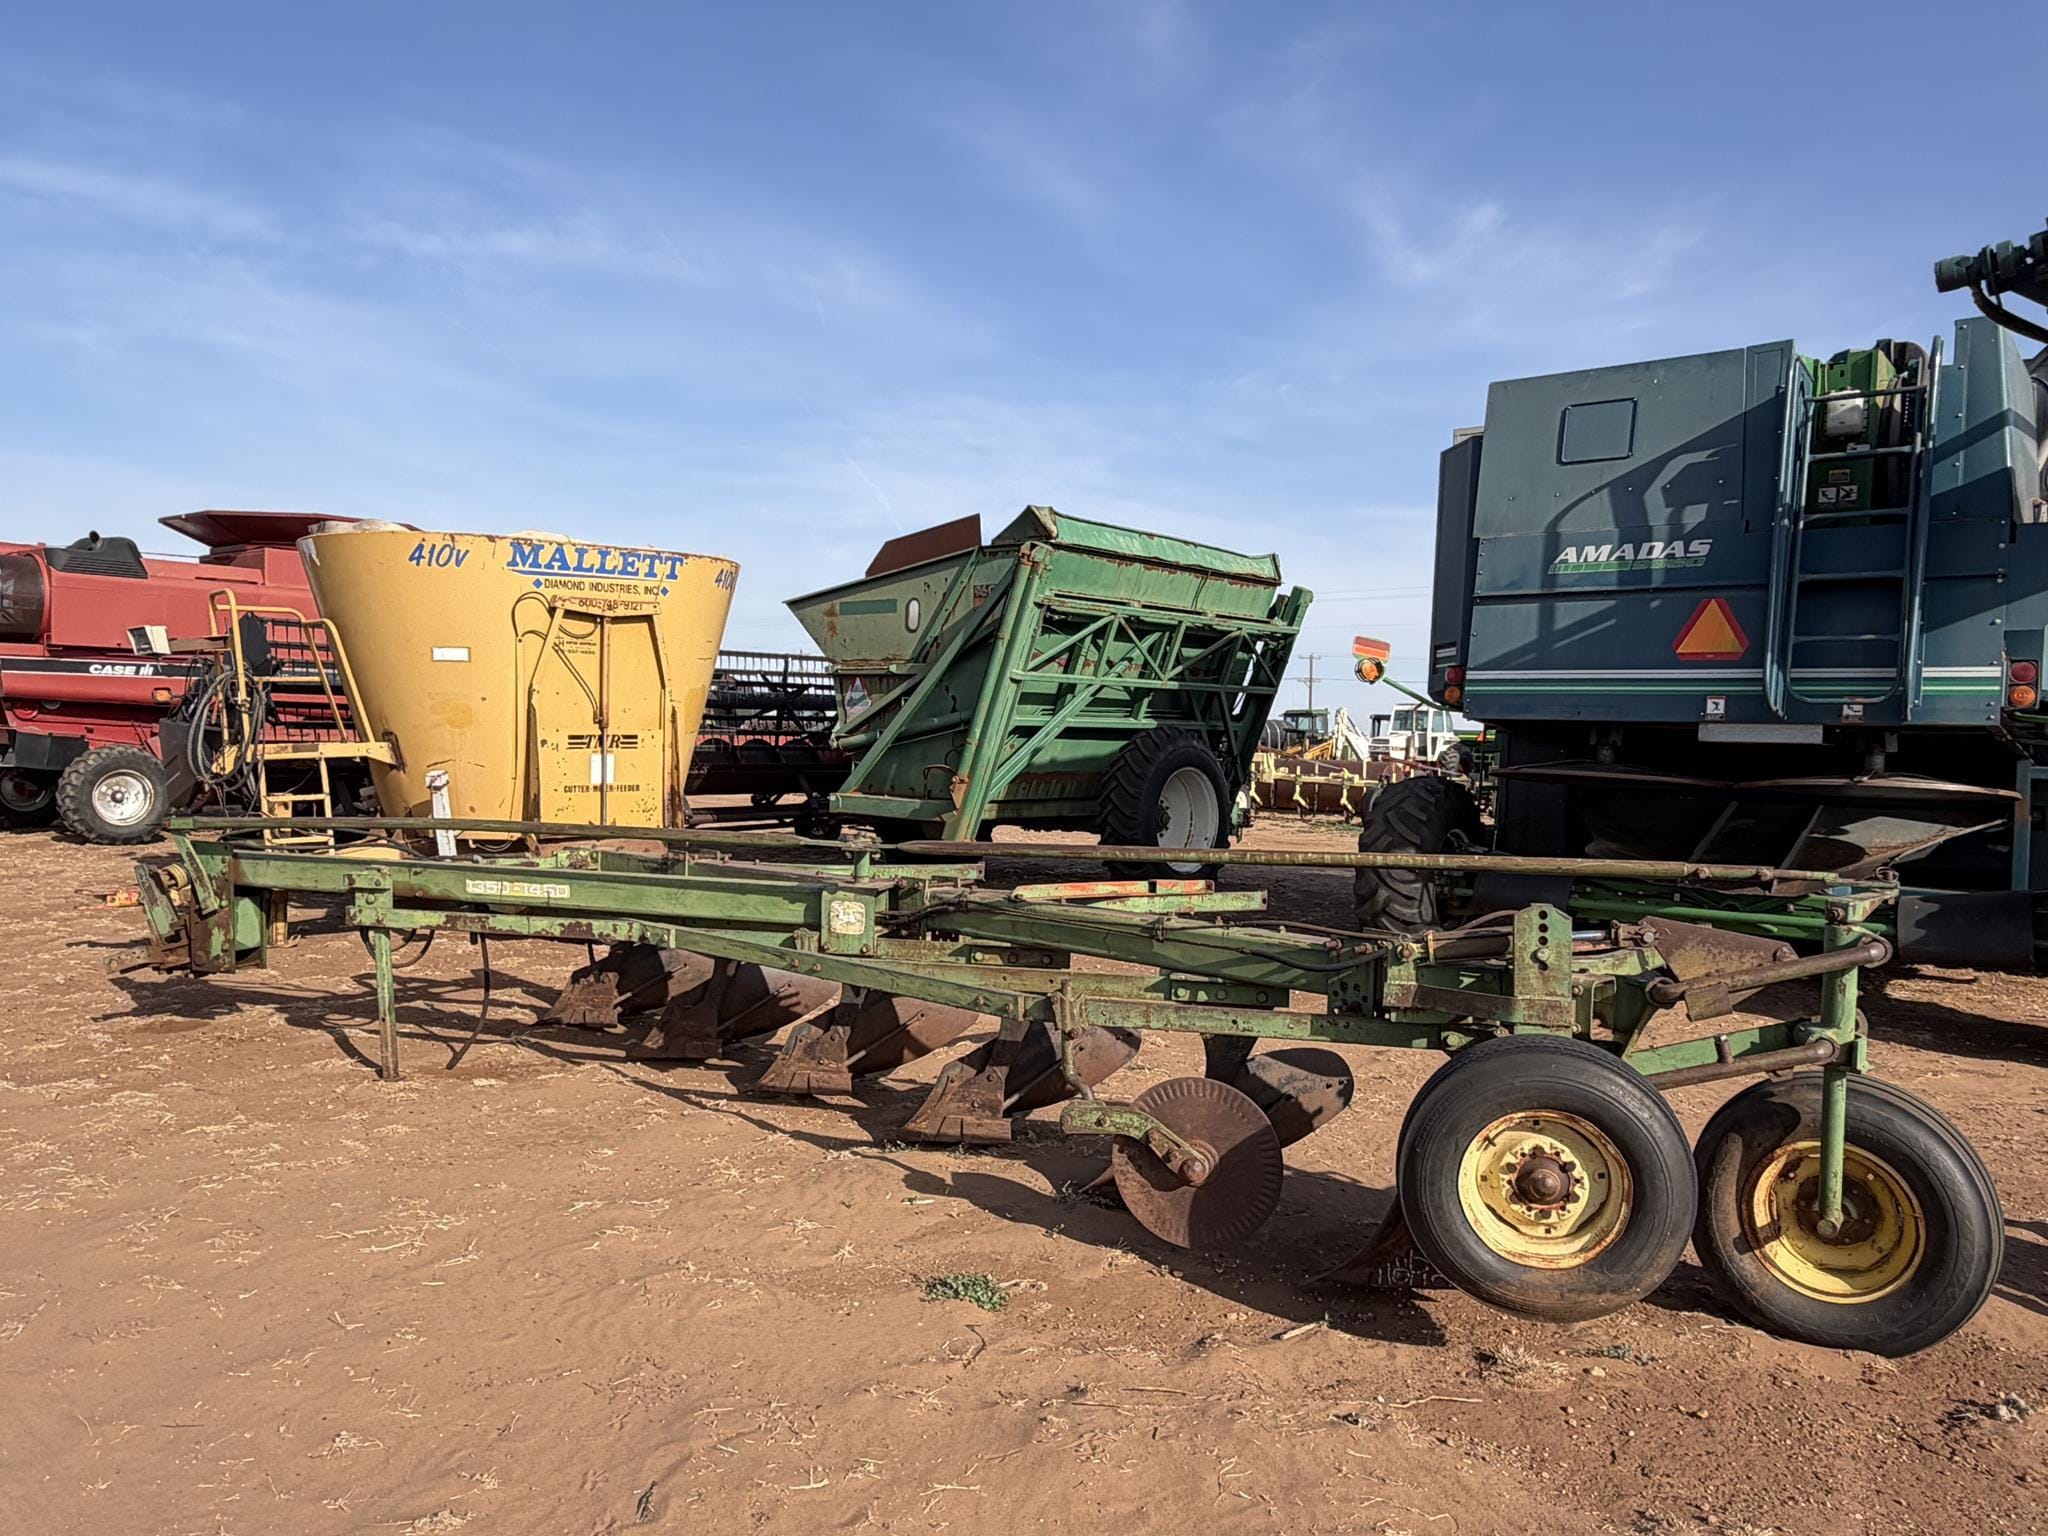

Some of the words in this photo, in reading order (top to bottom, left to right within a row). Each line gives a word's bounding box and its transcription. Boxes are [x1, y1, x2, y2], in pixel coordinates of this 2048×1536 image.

[506, 541, 684, 581] MALLETT
[1553, 539, 1713, 564] AMADAS
[544, 578, 585, 592] DIAMOND
[89, 664, 136, 676] CASE
